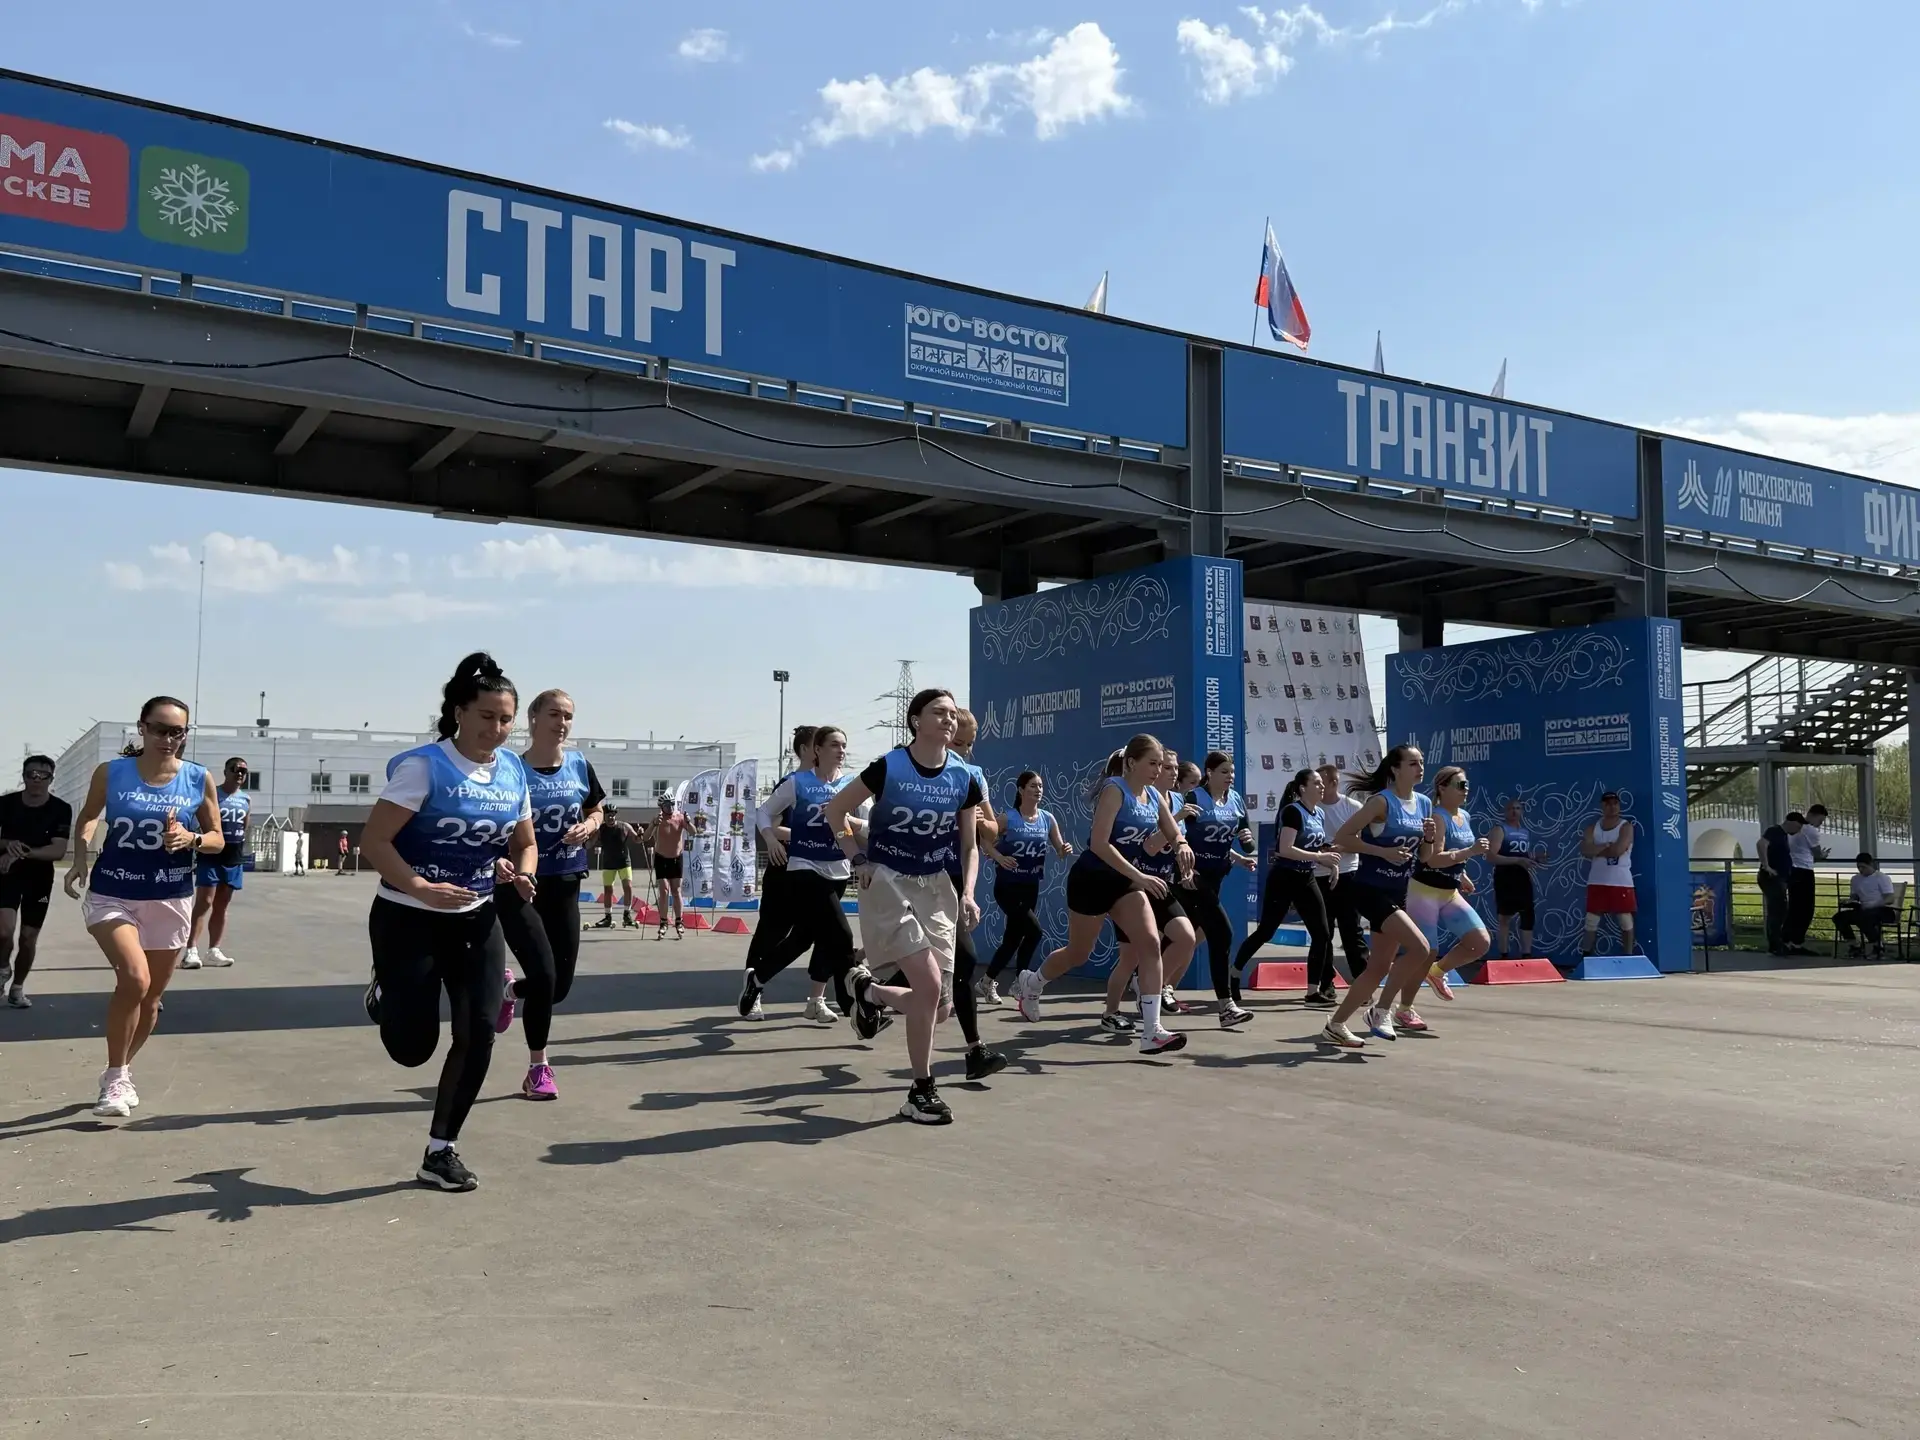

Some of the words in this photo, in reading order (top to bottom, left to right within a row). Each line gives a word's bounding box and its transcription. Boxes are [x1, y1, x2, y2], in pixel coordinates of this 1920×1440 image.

[0, 176, 91, 208] СКВЕ
[447, 189, 736, 356] СТАРТ
[906, 304, 1068, 354] ЮГО-ВОСТОК
[910, 363, 950, 376] ОКРУЖНОЙ
[951, 370, 1026, 389] БИАТЛОННО-ЛЫЖНЫЙ
[1026, 384, 1062, 397] КОМПЛЕКС
[1338, 379, 1553, 497] ТРАНЗИТ
[1738, 469, 1813, 507] МОСКОВСКАЯ
[1740, 496, 1782, 527] ЛЫЖНЯ
[1205, 565, 1213, 655] ЮГО-ВОСТОК
[1101, 675, 1174, 696] ЮГО-ВОСТОК
[1022, 689, 1080, 715] МОСКОВСКАЯ
[1022, 714, 1054, 736] ЛЫЖНЯ
[1206, 677, 1220, 754] ОСКОВСКАЯ
[1545, 713, 1630, 730] ЮГО-ВОСТОК
[1220, 714, 1234, 757] ЫЖНЯ
[1451, 723, 1520, 745] МОСКОВСКАЯ
[1451, 744, 1489, 762] ЛЫЖНЯ
[1659, 716, 1670, 786] МОСКОВСКАЯ
[1669, 747, 1679, 786] ЛЫЖНЯ
[118, 792, 191, 806] УРАЛХИМ
[548, 790, 574, 798] FACTORY
[898, 782, 960, 796] УРАЛХИМ
[922, 795, 951, 804] FACTORY
[146, 804, 181, 813] FACTOY
[220, 807, 247, 824] 212
[480, 802, 512, 811] FACTORY
[807, 804, 828, 826] 2
[113, 817, 178, 850] 23
[888, 806, 956, 835] 235
[1116, 826, 1155, 846] 24
